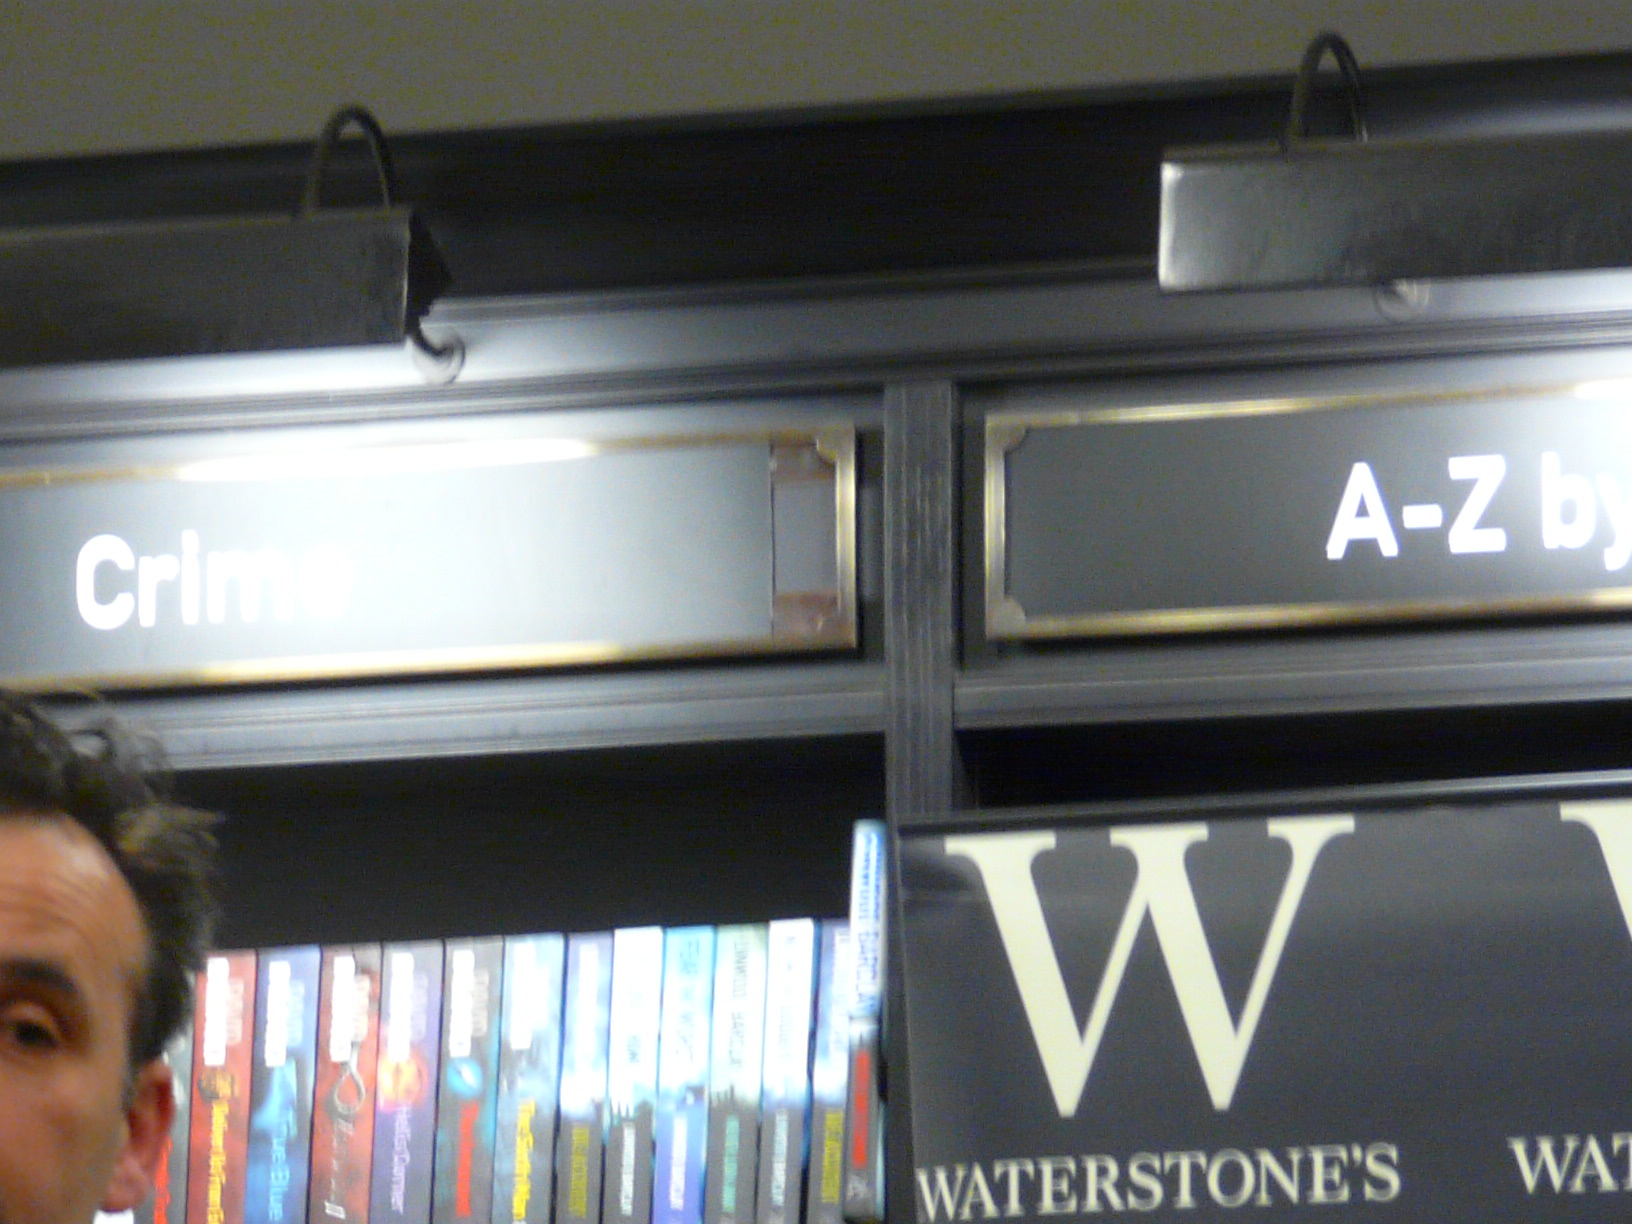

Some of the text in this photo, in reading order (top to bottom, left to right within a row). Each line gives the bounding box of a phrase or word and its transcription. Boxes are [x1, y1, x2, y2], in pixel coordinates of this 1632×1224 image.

[1326, 454, 1507, 560] A-Z
[76, 528, 352, 630] Crime
[945, 814, 1355, 1118] W
[269, 1164, 290, 1221] Blue
[916, 1142, 1400, 1223] WATERSTONE'S
